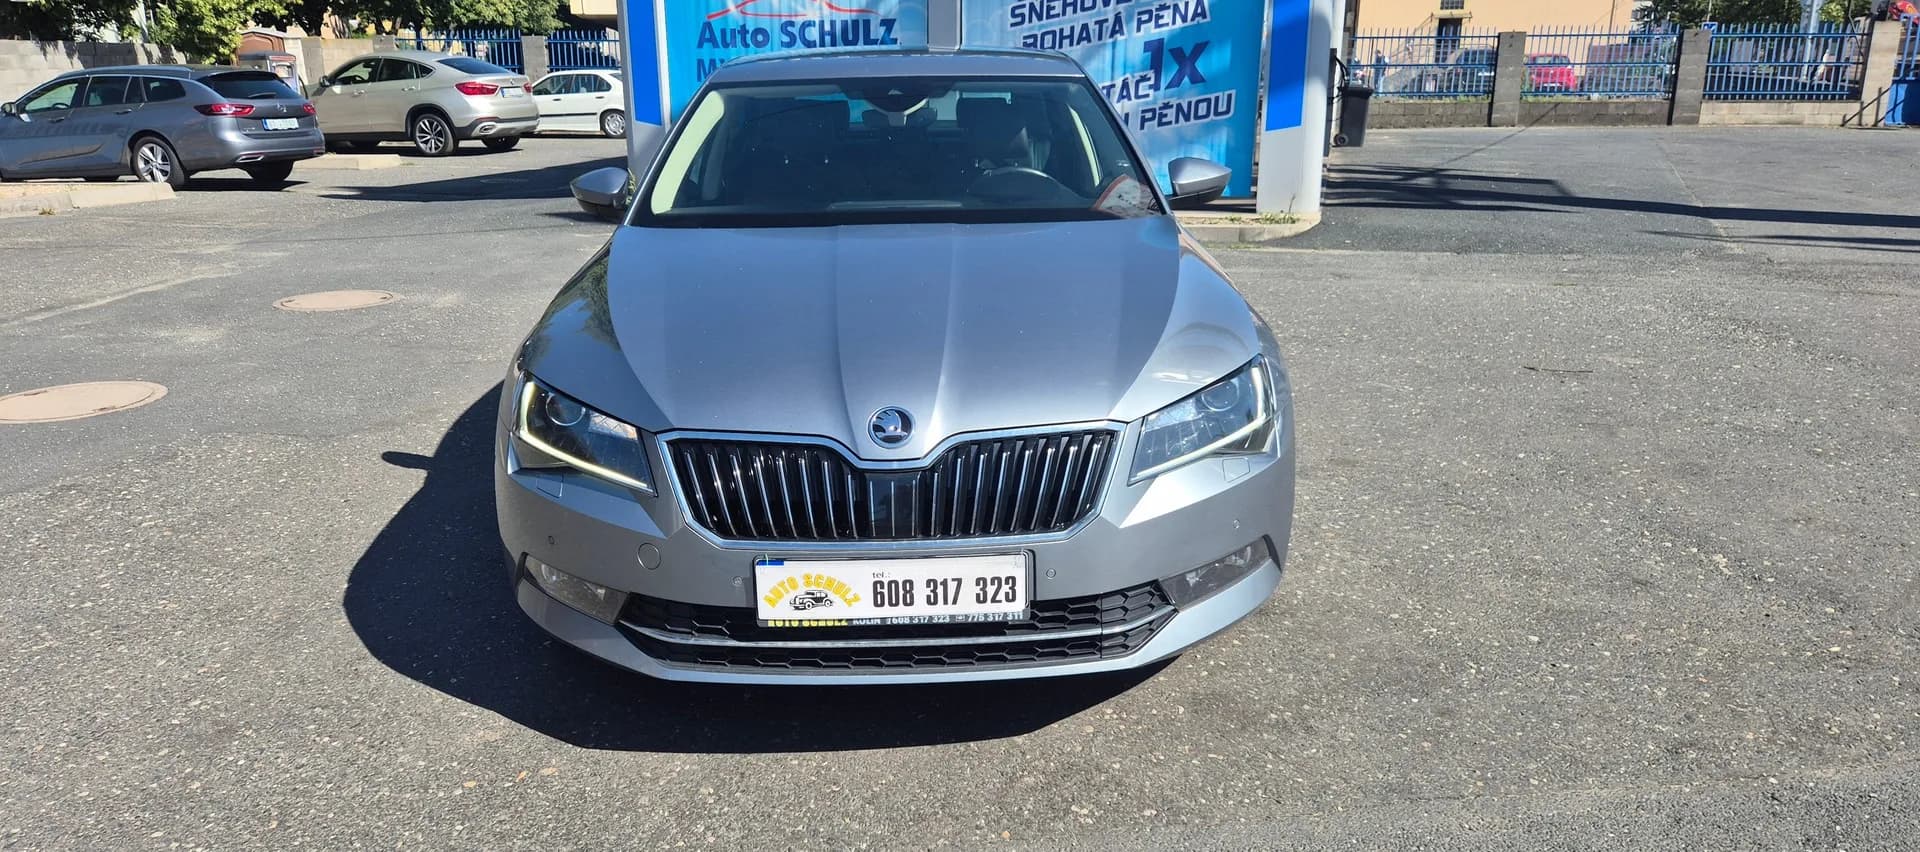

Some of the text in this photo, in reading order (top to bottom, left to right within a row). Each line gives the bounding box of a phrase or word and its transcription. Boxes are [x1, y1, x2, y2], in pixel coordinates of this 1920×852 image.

[1136, 0, 1207, 33] PĚNA
[697, 18, 898, 49] Auto SCHULZ
[1140, 93, 1233, 131] PĚNOU
[763, 573, 861, 608] AUTO SCHULZ
[872, 576, 1017, 608] 608 317 323
